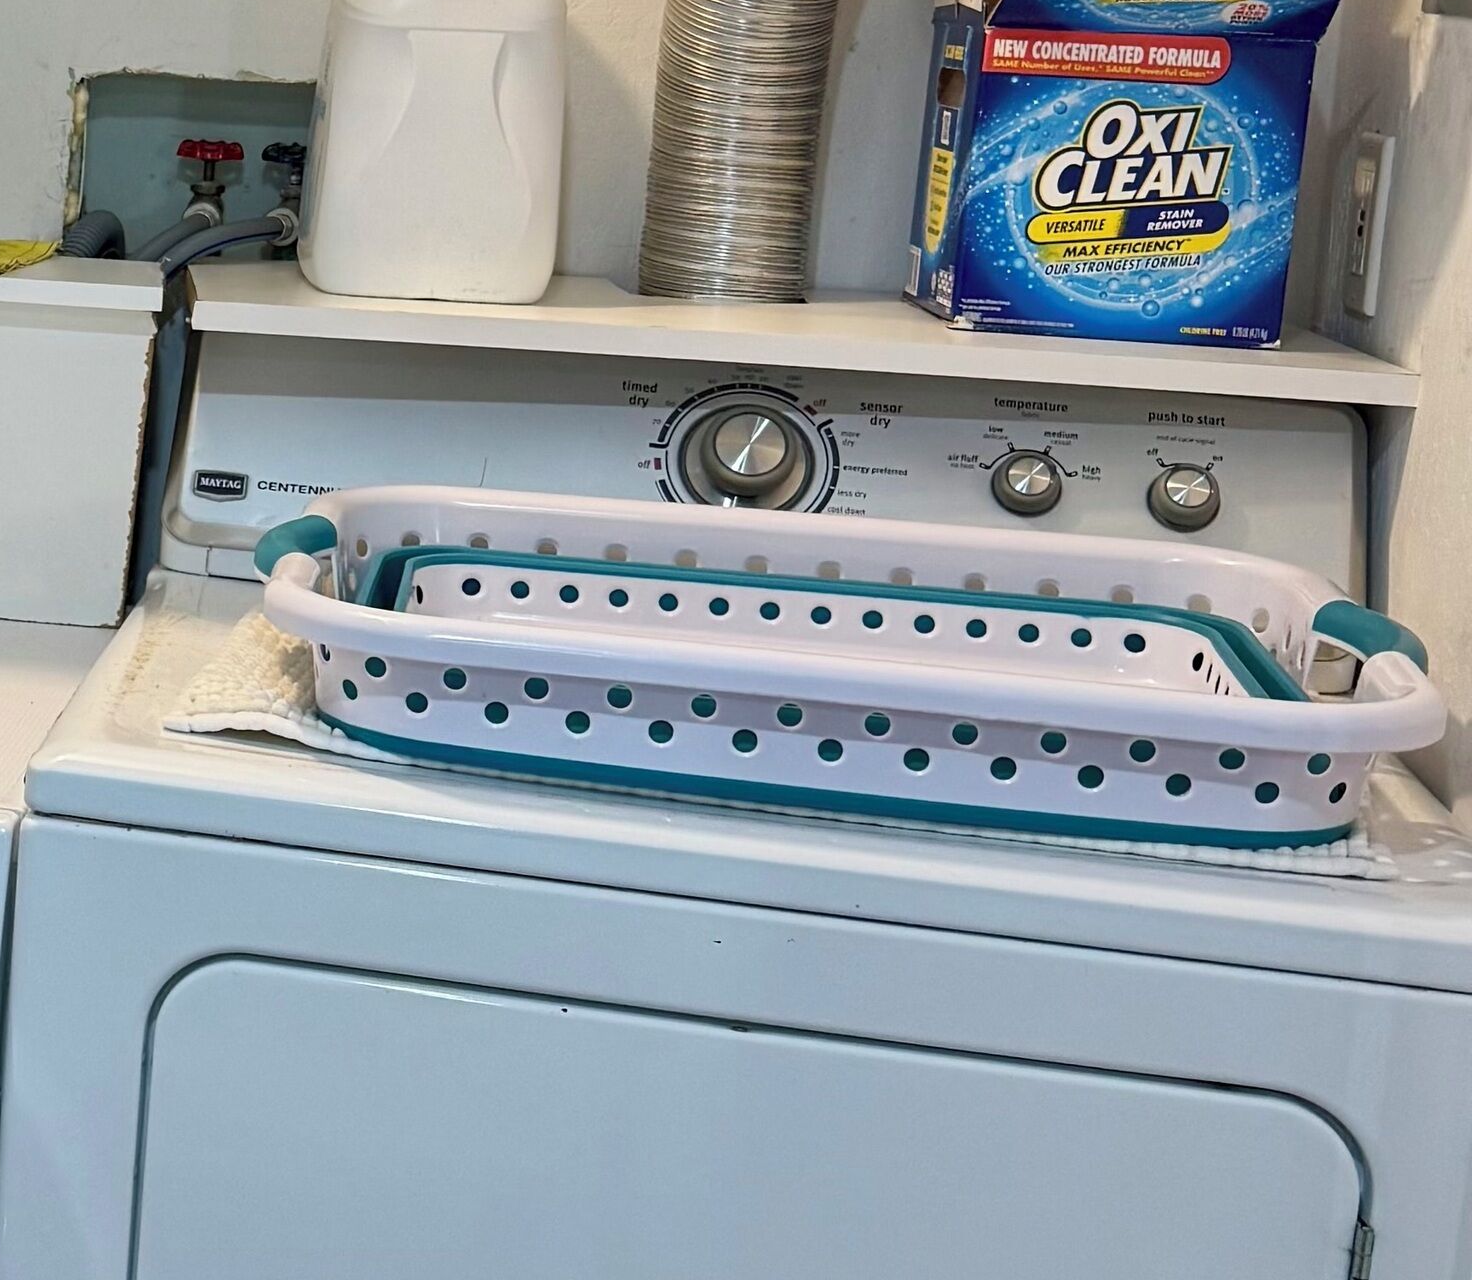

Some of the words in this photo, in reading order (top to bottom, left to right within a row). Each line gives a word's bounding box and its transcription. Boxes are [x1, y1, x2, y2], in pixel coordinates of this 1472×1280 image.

[994, 39, 1027, 59] NEW
[1032, 41, 1144, 64] CONCENTRATED
[1148, 48, 1220, 68] FORMULA
[992, 60, 1019, 68] SAME
[1022, 61, 1059, 70] Number
[1062, 62, 1071, 70] of
[1134, 67, 1177, 76] Powerful
[1086, 104, 1196, 159] OXI
[1039, 150, 1226, 207] CLEAN
[1158, 209, 1194, 220] STAIN
[1046, 218, 1105, 234] VERSATILE
[1146, 220, 1203, 231] REMOVER
[1063, 246, 1099, 258] MAX
[1104, 240, 1185, 255] EFFICIENCY
[1045, 264, 1074, 275] OUR
[1075, 258, 1142, 274] STRONGEST
[1145, 255, 1201, 268] FORMULA
[622, 380, 658, 393] timed
[629, 395, 649, 408] dry
[814, 399, 826, 408] off
[859, 401, 903, 414] sensor
[994, 397, 1068, 412] temperature
[870, 416, 891, 428] dry
[1148, 412, 1178, 423] push
[1182, 413, 1194, 423] to
[1197, 416, 1225, 426] start
[988, 425, 1004, 433] low
[1044, 430, 1078, 439] medium
[842, 438, 855, 447] dry
[638, 460, 651, 469] off
[948, 454, 959, 462] air
[960, 454, 979, 463] fluff
[843, 465, 870, 474] energy
[872, 466, 908, 476] preferred
[1082, 465, 1101, 475] high
[200, 477, 242, 489] MAYTAG
[258, 481, 341, 495] CENTENN
